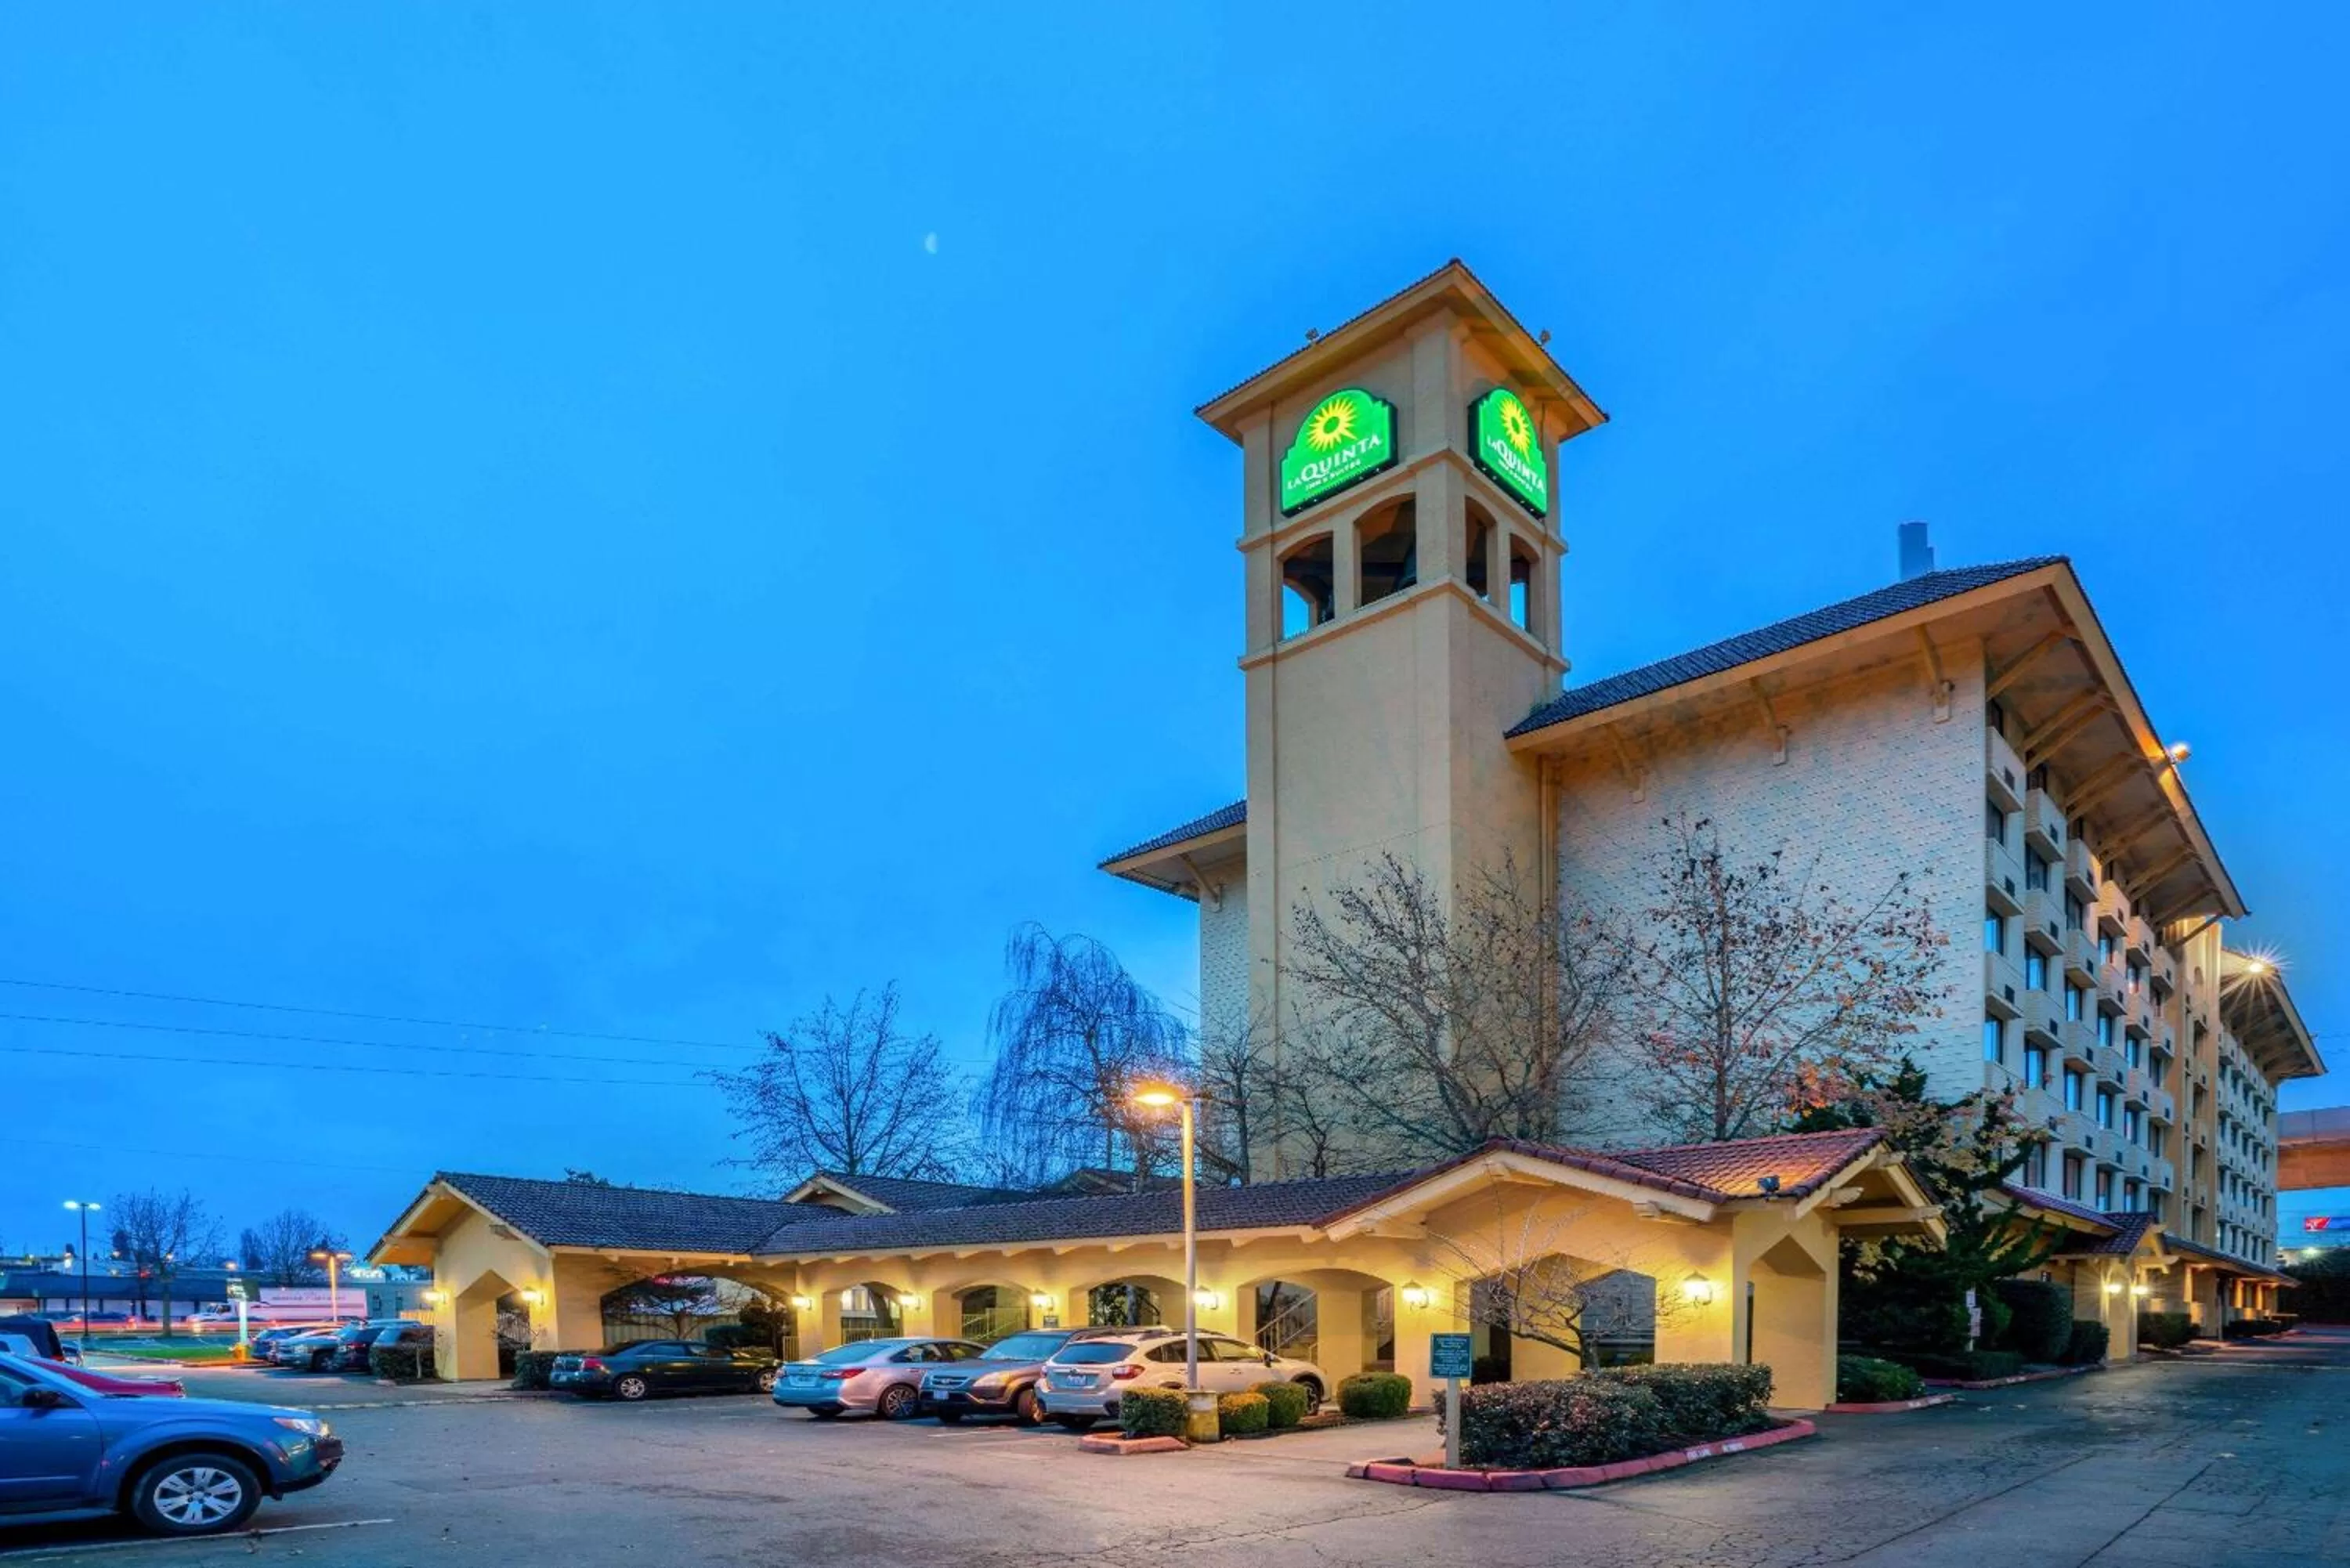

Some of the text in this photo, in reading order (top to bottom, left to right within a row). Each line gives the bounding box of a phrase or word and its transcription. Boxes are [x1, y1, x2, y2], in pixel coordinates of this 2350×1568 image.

[1287, 476, 1302, 490] LA
[1301, 434, 1382, 482] QUINTA
[1496, 439, 1546, 495] QUINTA
